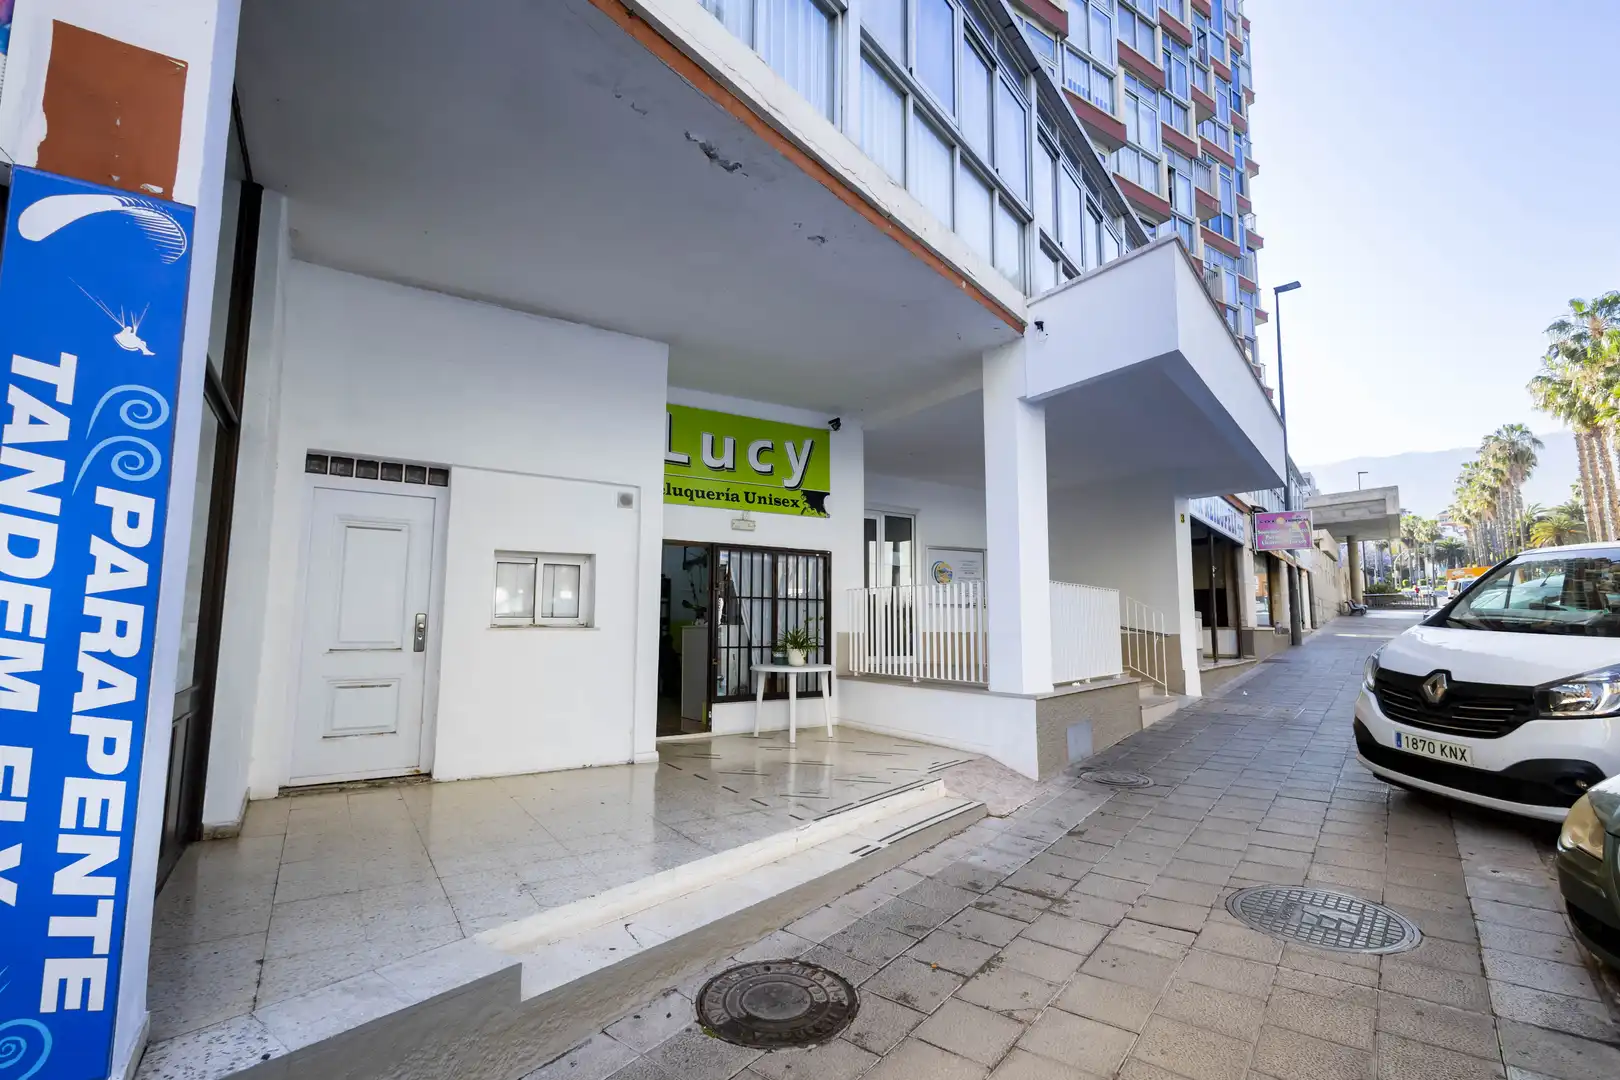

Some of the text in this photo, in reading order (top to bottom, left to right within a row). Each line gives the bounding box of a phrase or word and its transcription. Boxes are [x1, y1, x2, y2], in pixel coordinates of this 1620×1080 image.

[664, 411, 814, 491] Lucy
[0, 351, 78, 713] TANDEM
[663, 482, 800, 508] luquería Unisex
[39, 485, 156, 1013] PARAPENTE
[1405, 736, 1467, 762] 1870 KNX
